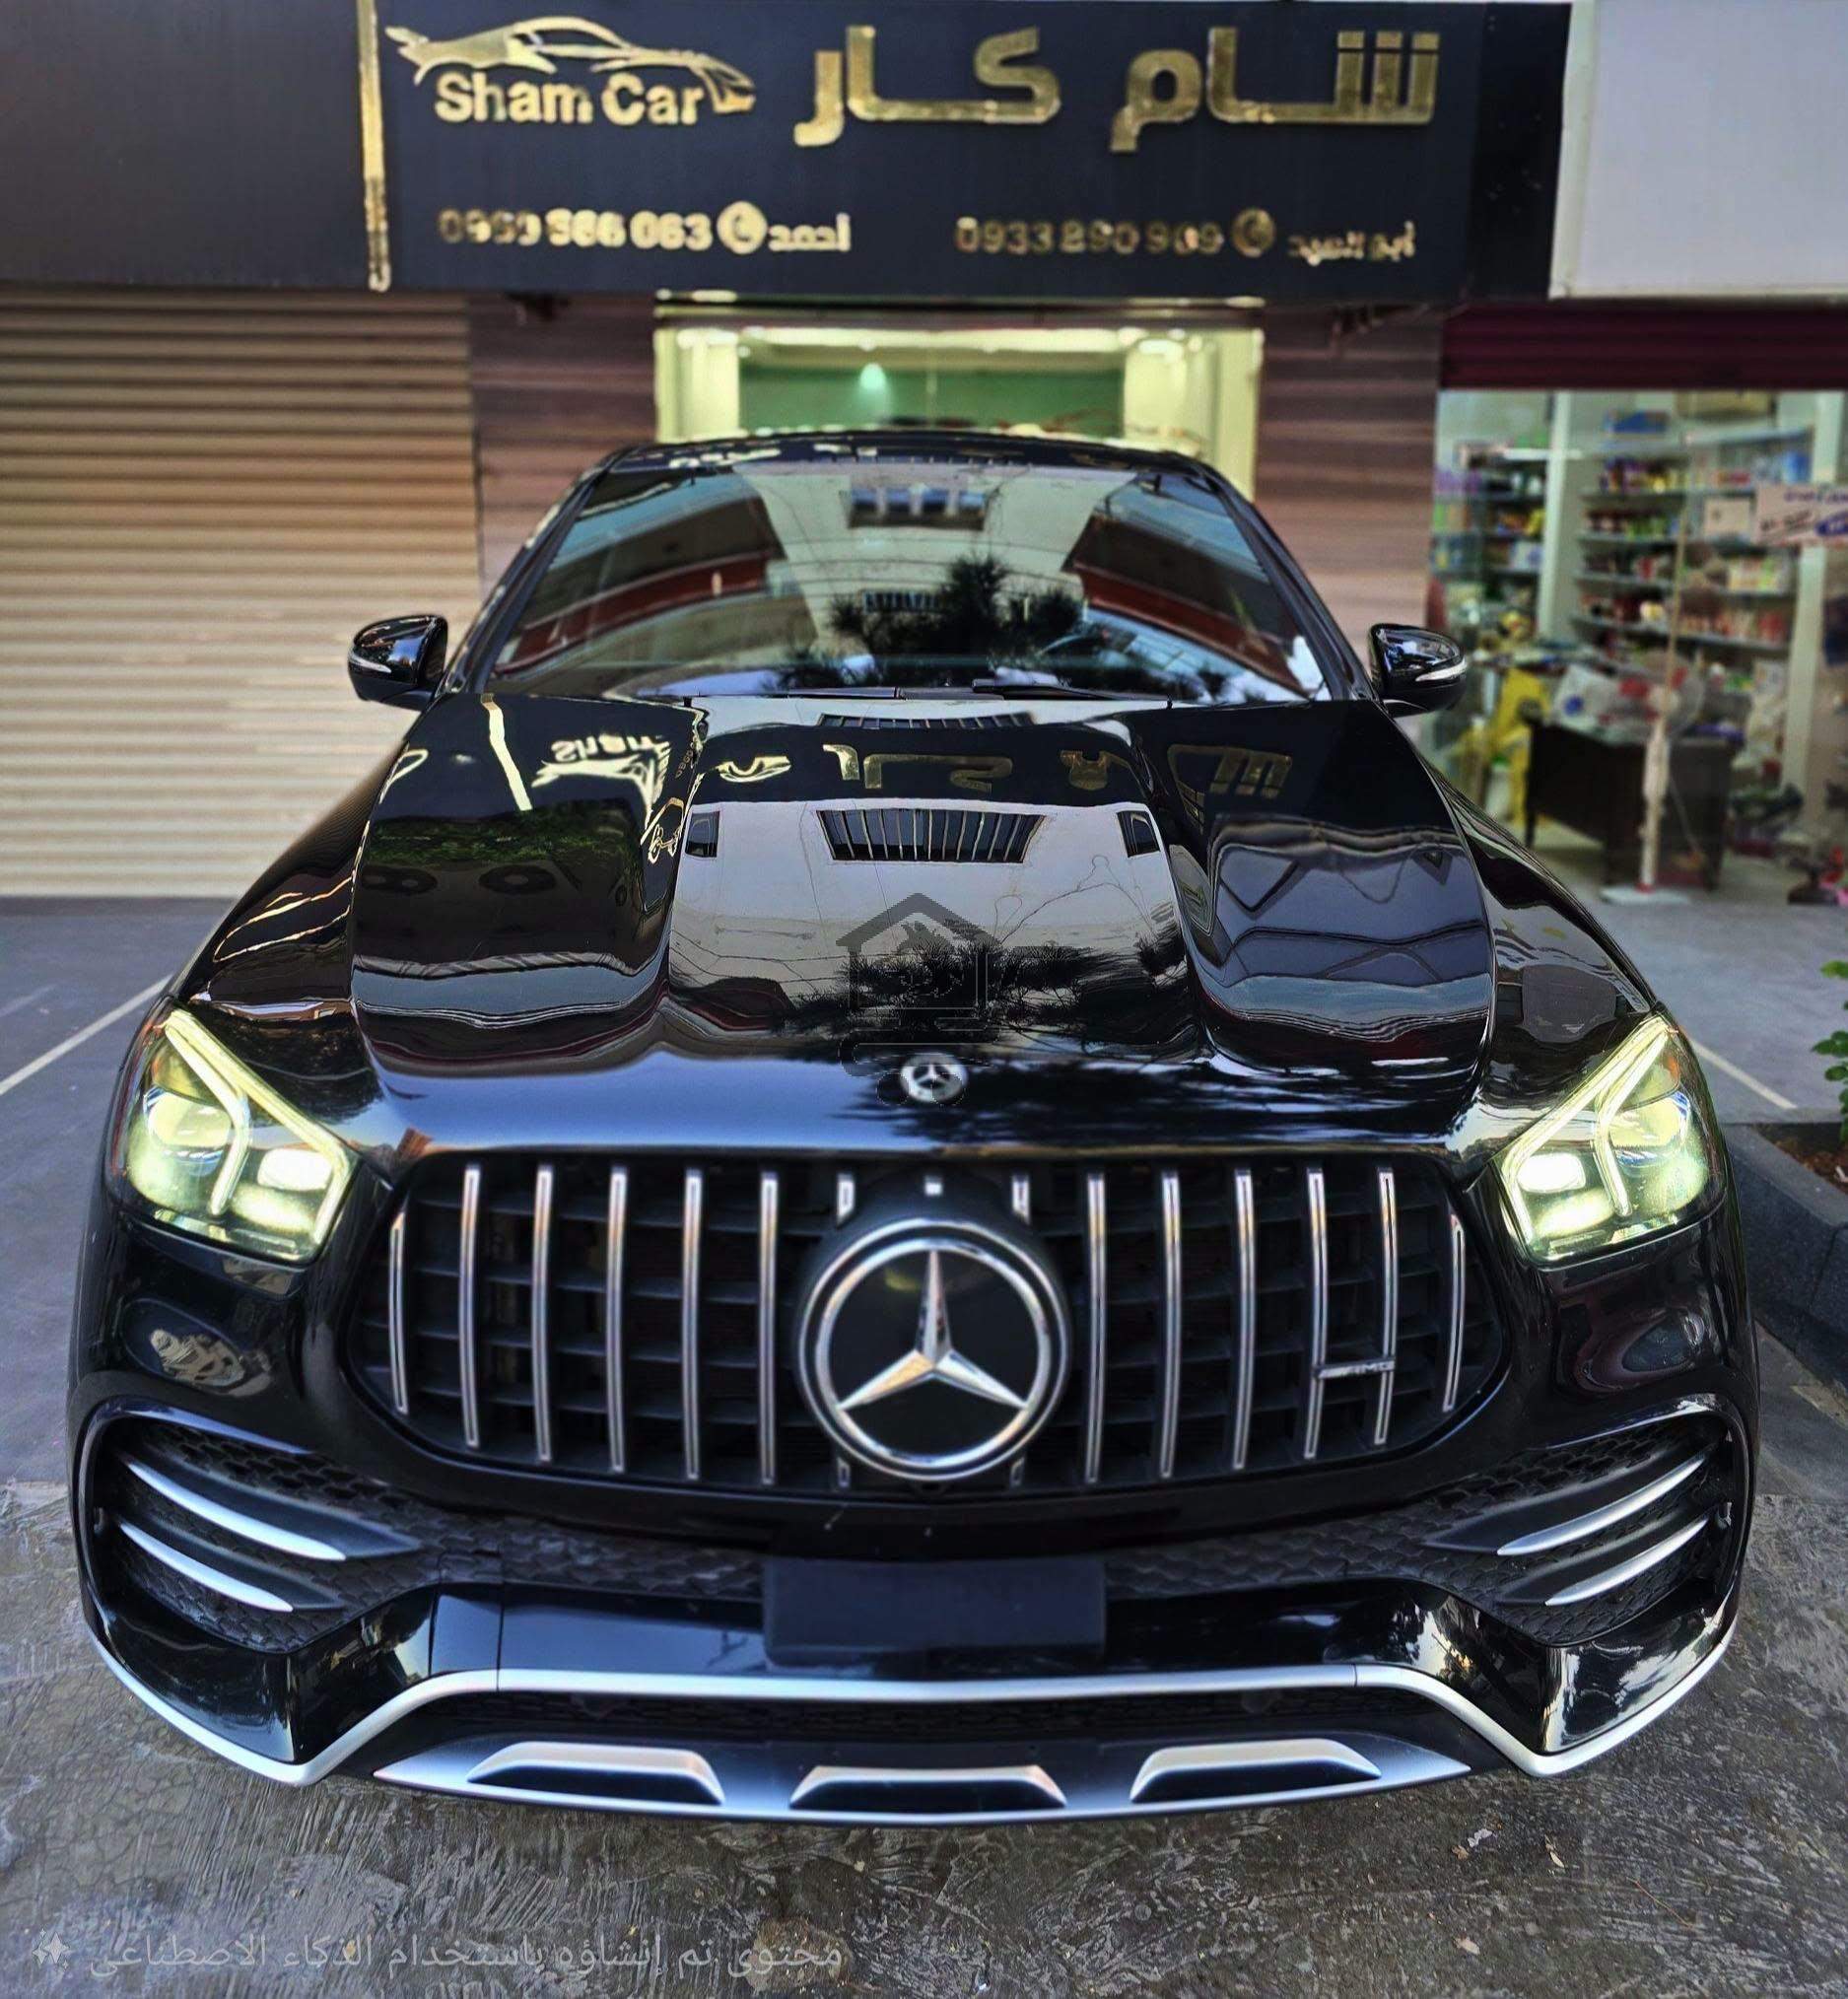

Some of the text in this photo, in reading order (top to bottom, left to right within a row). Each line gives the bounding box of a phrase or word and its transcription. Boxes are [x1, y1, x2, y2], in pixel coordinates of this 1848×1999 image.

[435, 72, 704, 125] Sham Car
[793, 26, 1439, 152] شام كار
[955, 216, 1055, 254] 0933
